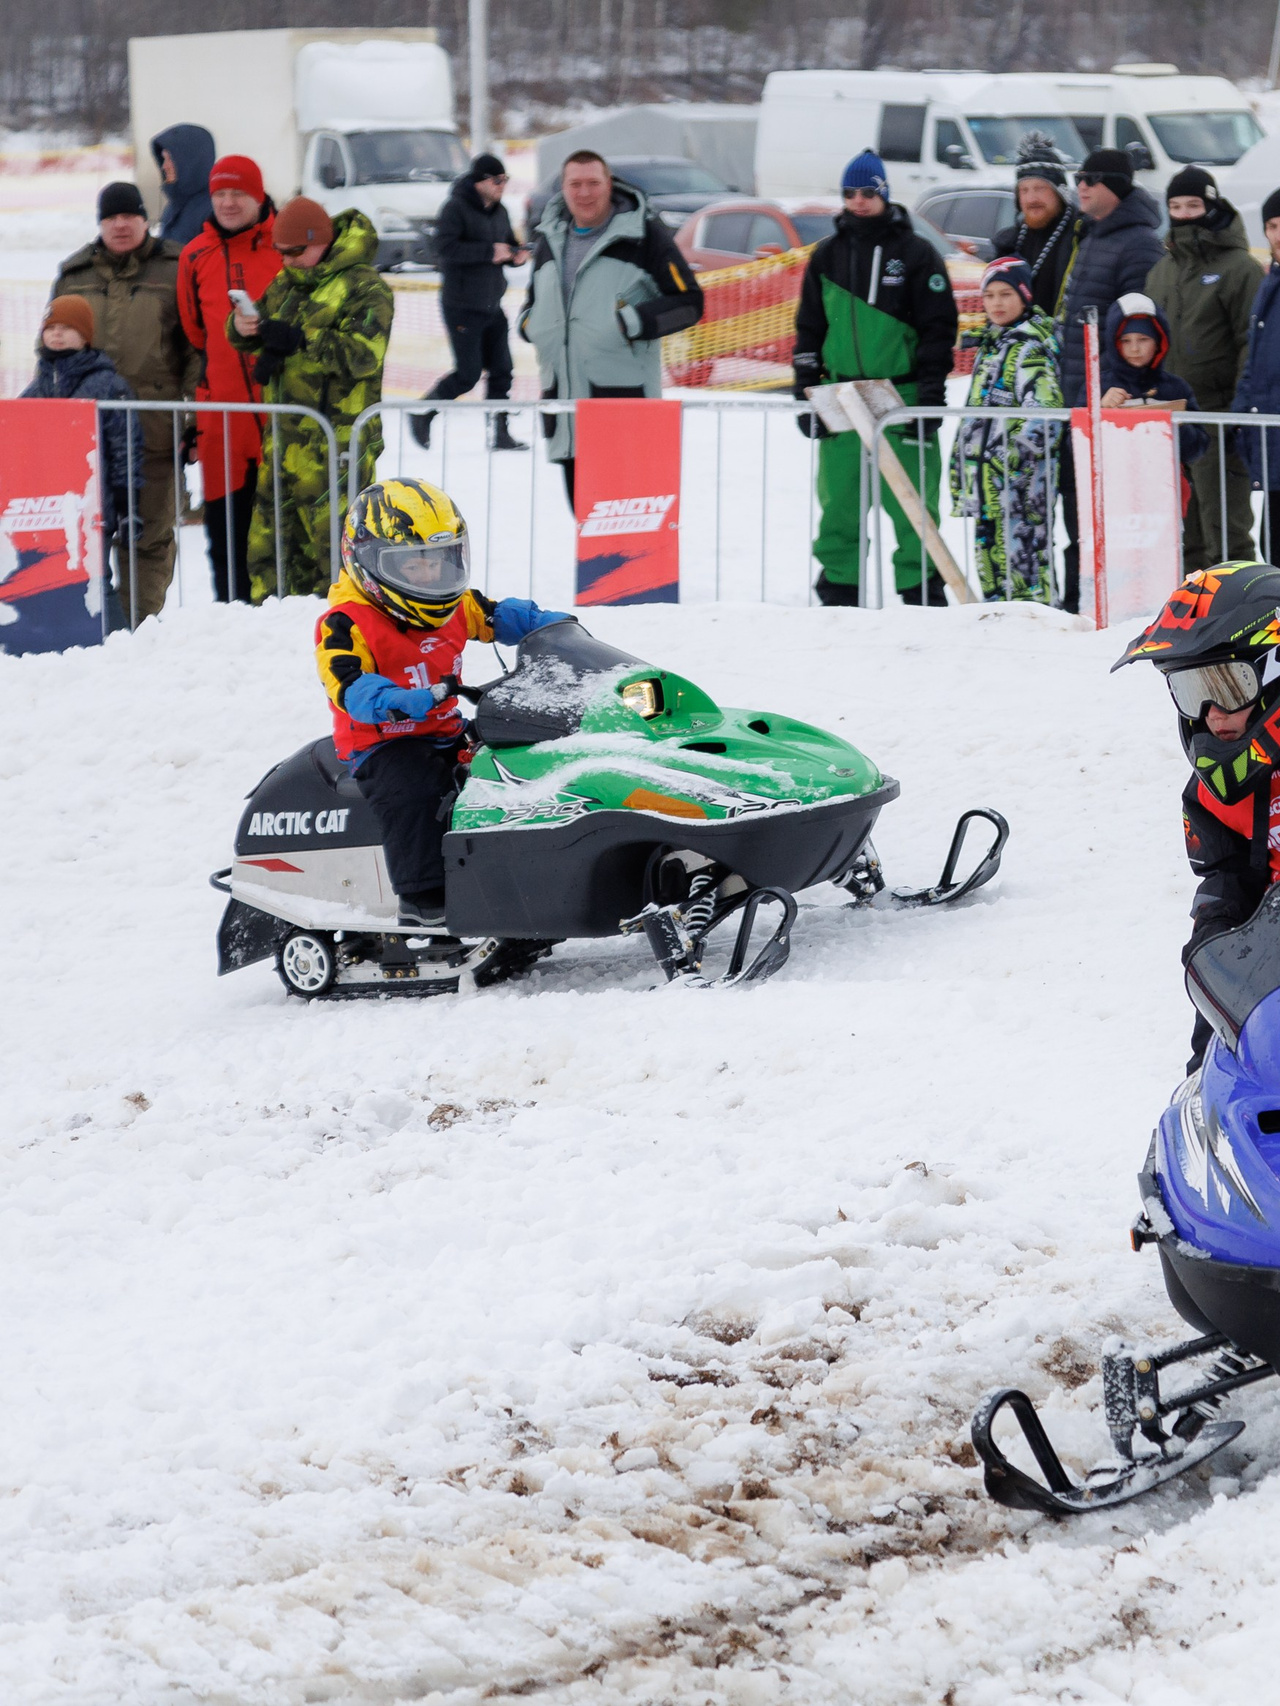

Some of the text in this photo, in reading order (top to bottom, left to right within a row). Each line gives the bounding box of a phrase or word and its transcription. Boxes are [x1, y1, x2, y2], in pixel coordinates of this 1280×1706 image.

[587, 494, 676, 518] SNOW
[1230, 629, 1244, 641] FXR
[404, 662, 431, 690] 31
[247, 808, 349, 836] ARCTIC CAT
[503, 800, 582, 821] PRO
[1190, 1096, 1206, 1131] SRX
